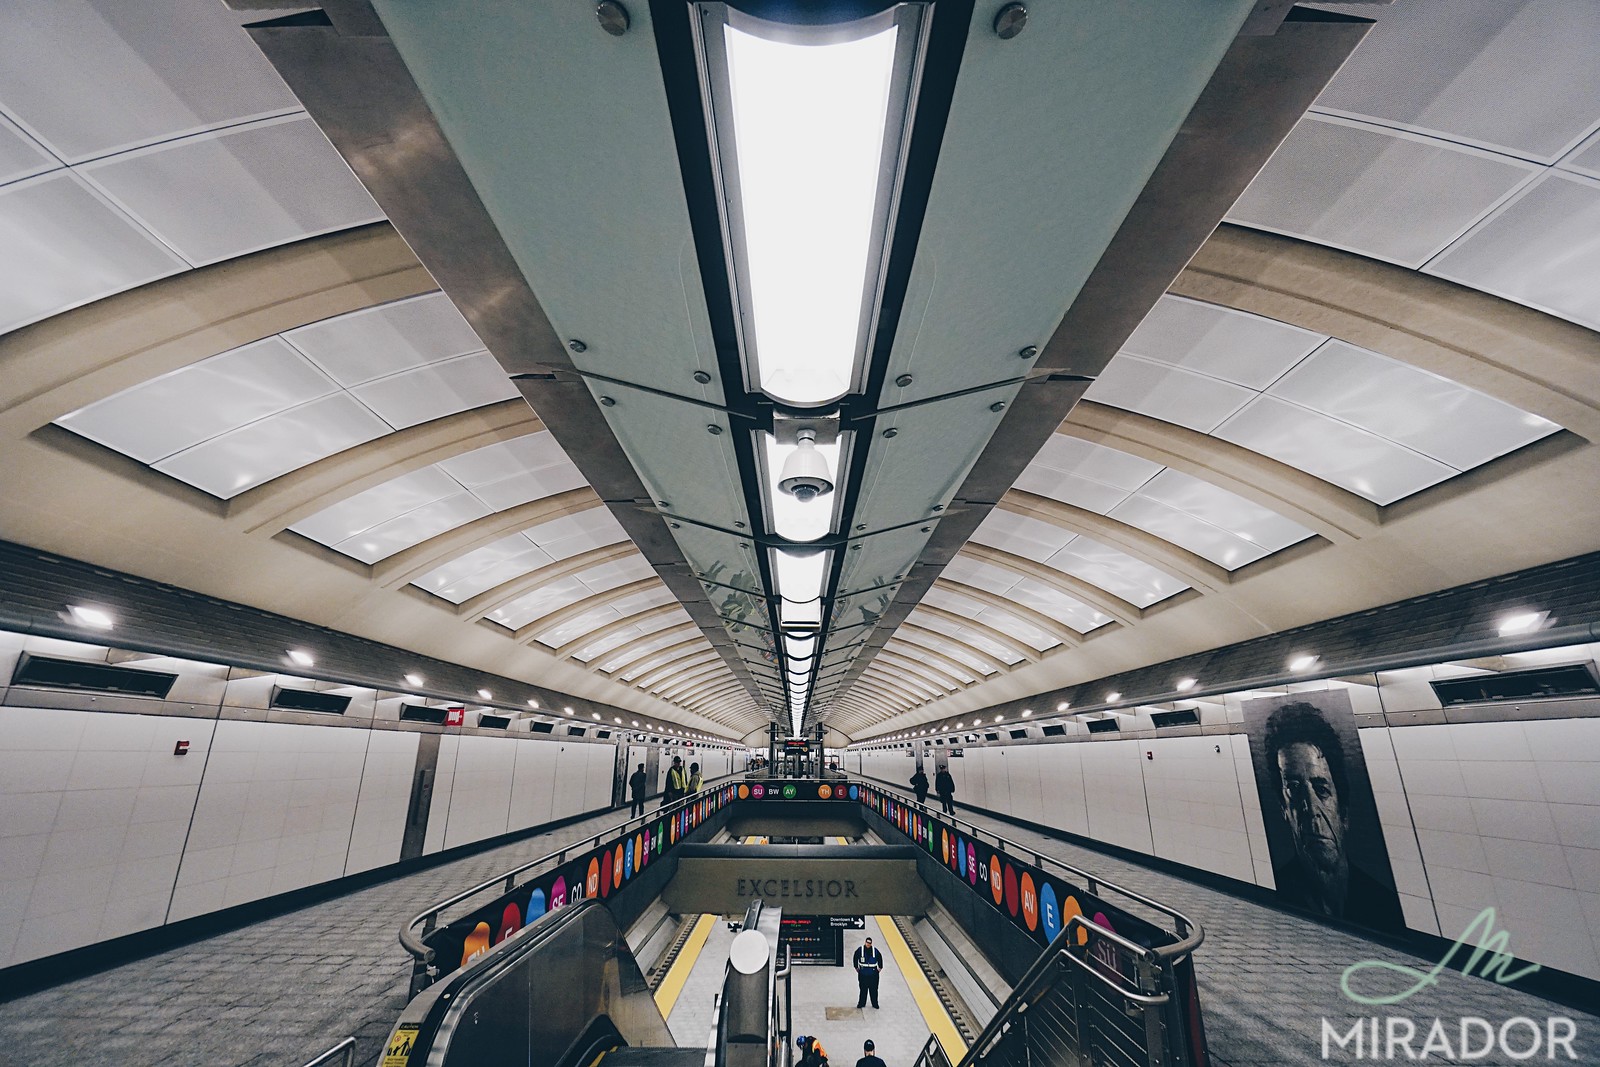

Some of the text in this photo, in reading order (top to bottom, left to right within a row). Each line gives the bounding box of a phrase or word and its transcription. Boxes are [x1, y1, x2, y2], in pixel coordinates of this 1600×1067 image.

[571, 882, 583, 903] CO
[588, 873, 598, 893] ND
[737, 879, 859, 898] EXCELSIOR
[968, 855, 976, 874] SE
[979, 861, 988, 882] CO
[991, 869, 1001, 891] ND
[1024, 890, 1034, 914] AV
[1046, 902, 1055, 929] E
